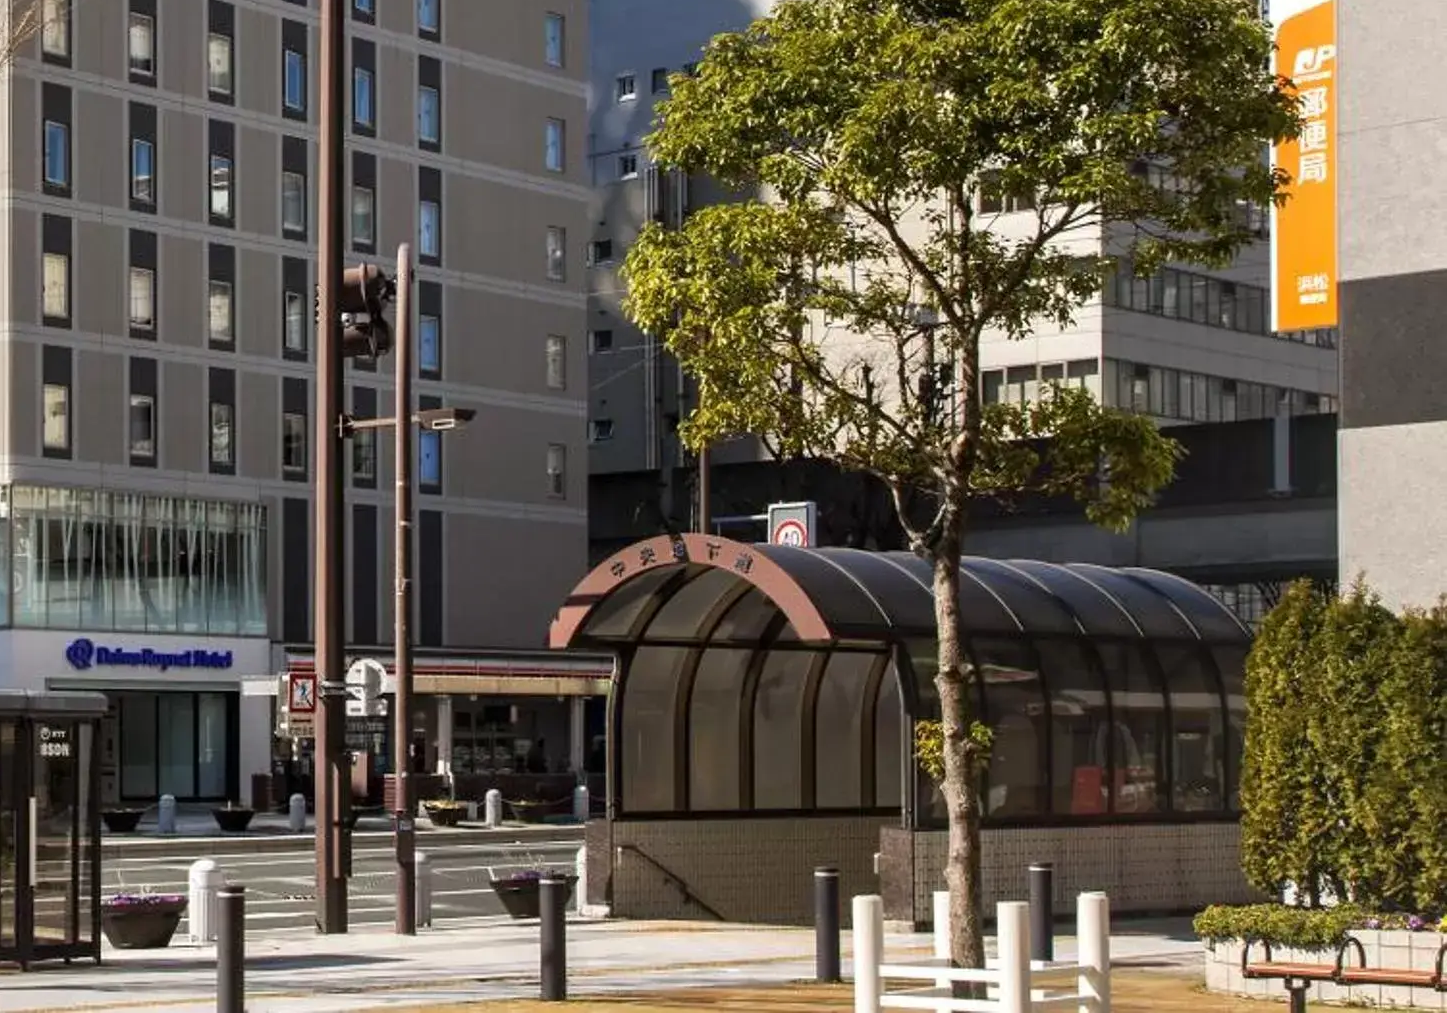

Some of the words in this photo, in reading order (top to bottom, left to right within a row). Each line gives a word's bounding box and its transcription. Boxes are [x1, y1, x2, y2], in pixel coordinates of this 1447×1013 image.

[1294, 44, 1337, 73] JP
[1297, 85, 1328, 186] 郵便局
[193, 649, 234, 669] Hotel
